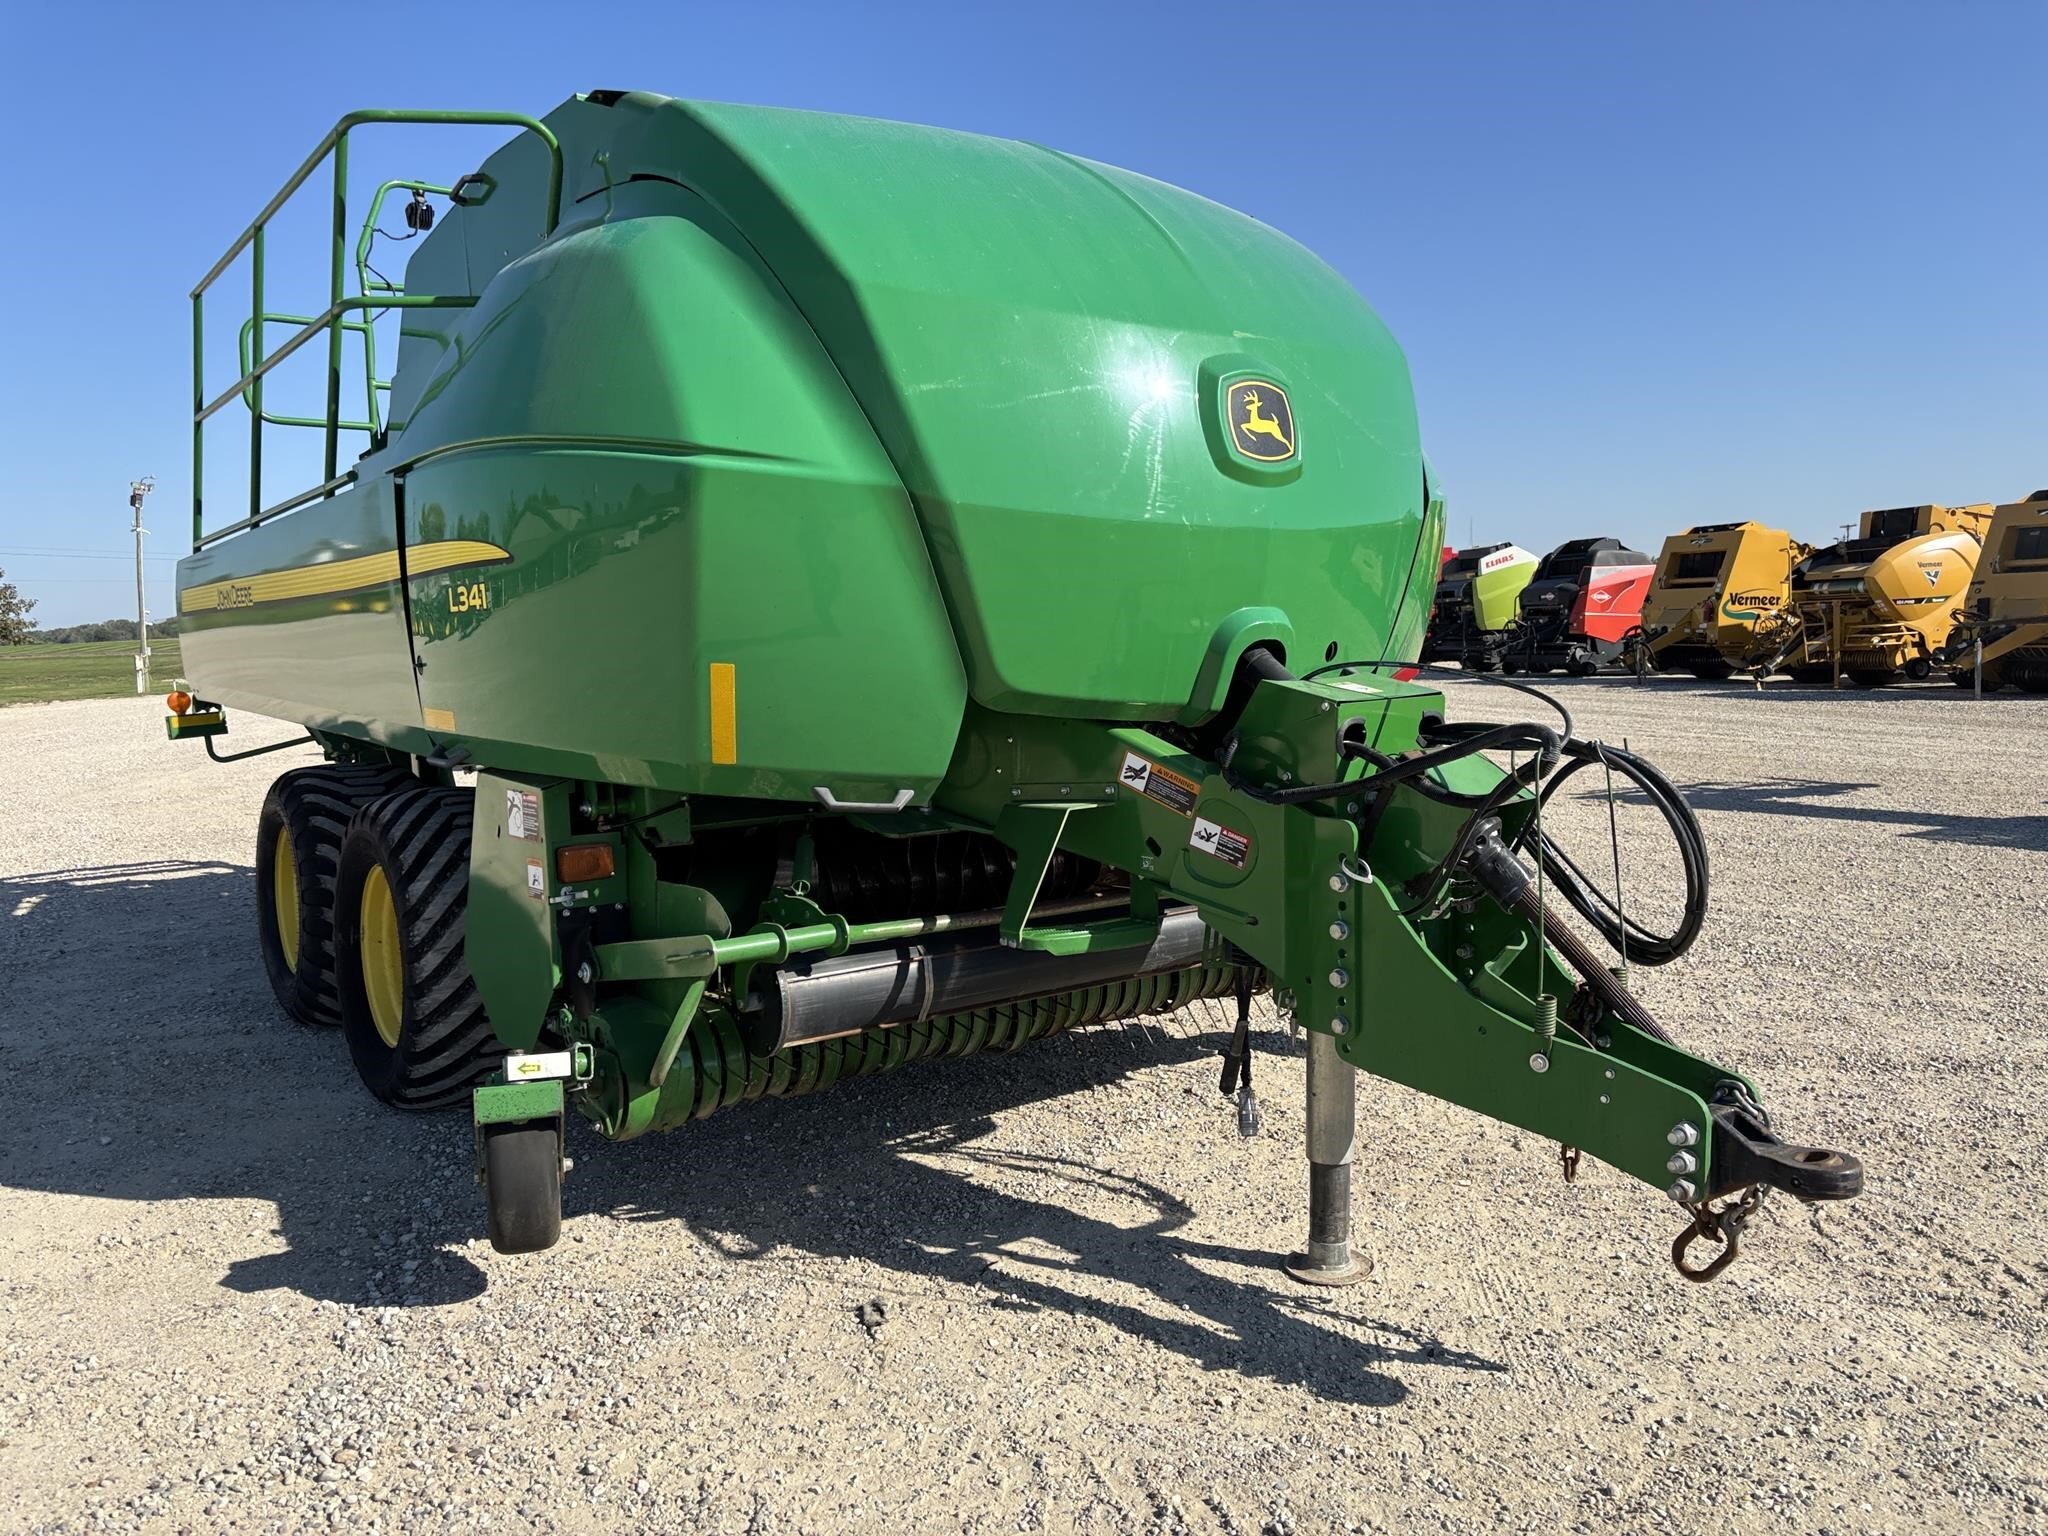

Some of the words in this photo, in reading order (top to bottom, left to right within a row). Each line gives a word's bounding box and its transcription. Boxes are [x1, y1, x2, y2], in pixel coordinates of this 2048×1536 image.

[1485, 554, 1514, 569] CLAAS
[1917, 561, 1943, 569] Vermeer
[448, 583, 487, 613] L341
[1729, 593, 1781, 606] Vermeer
[1163, 772, 1194, 791] WARNING
[1227, 830, 1248, 844] DANGER
